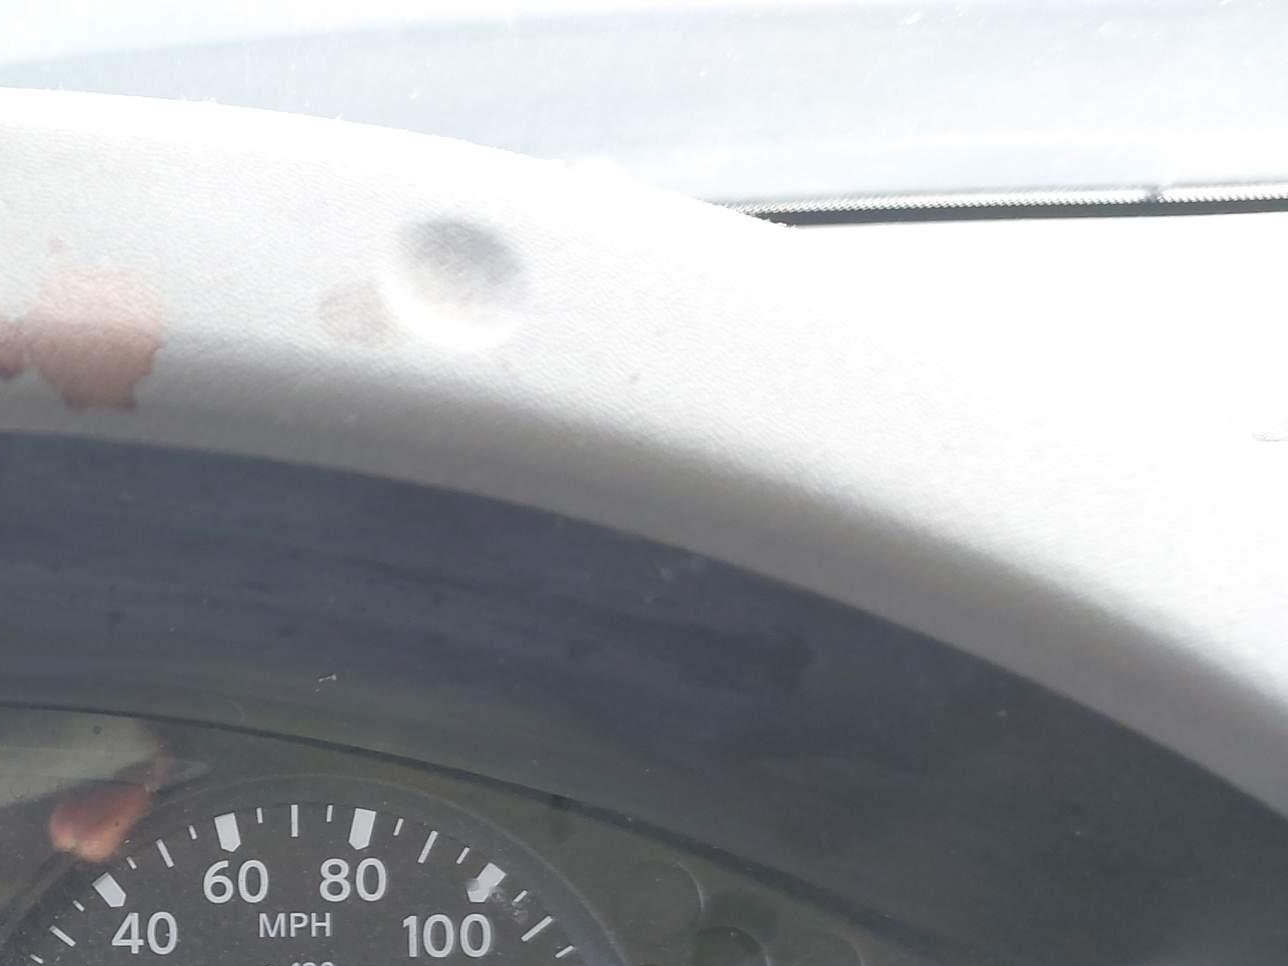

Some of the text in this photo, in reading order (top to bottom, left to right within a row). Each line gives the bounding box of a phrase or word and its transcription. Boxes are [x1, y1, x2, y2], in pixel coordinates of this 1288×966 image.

[203, 859, 270, 903] 60
[319, 858, 387, 902] 80
[112, 911, 178, 955] 40
[258, 913, 333, 938] MPH
[403, 914, 492, 959] 100
